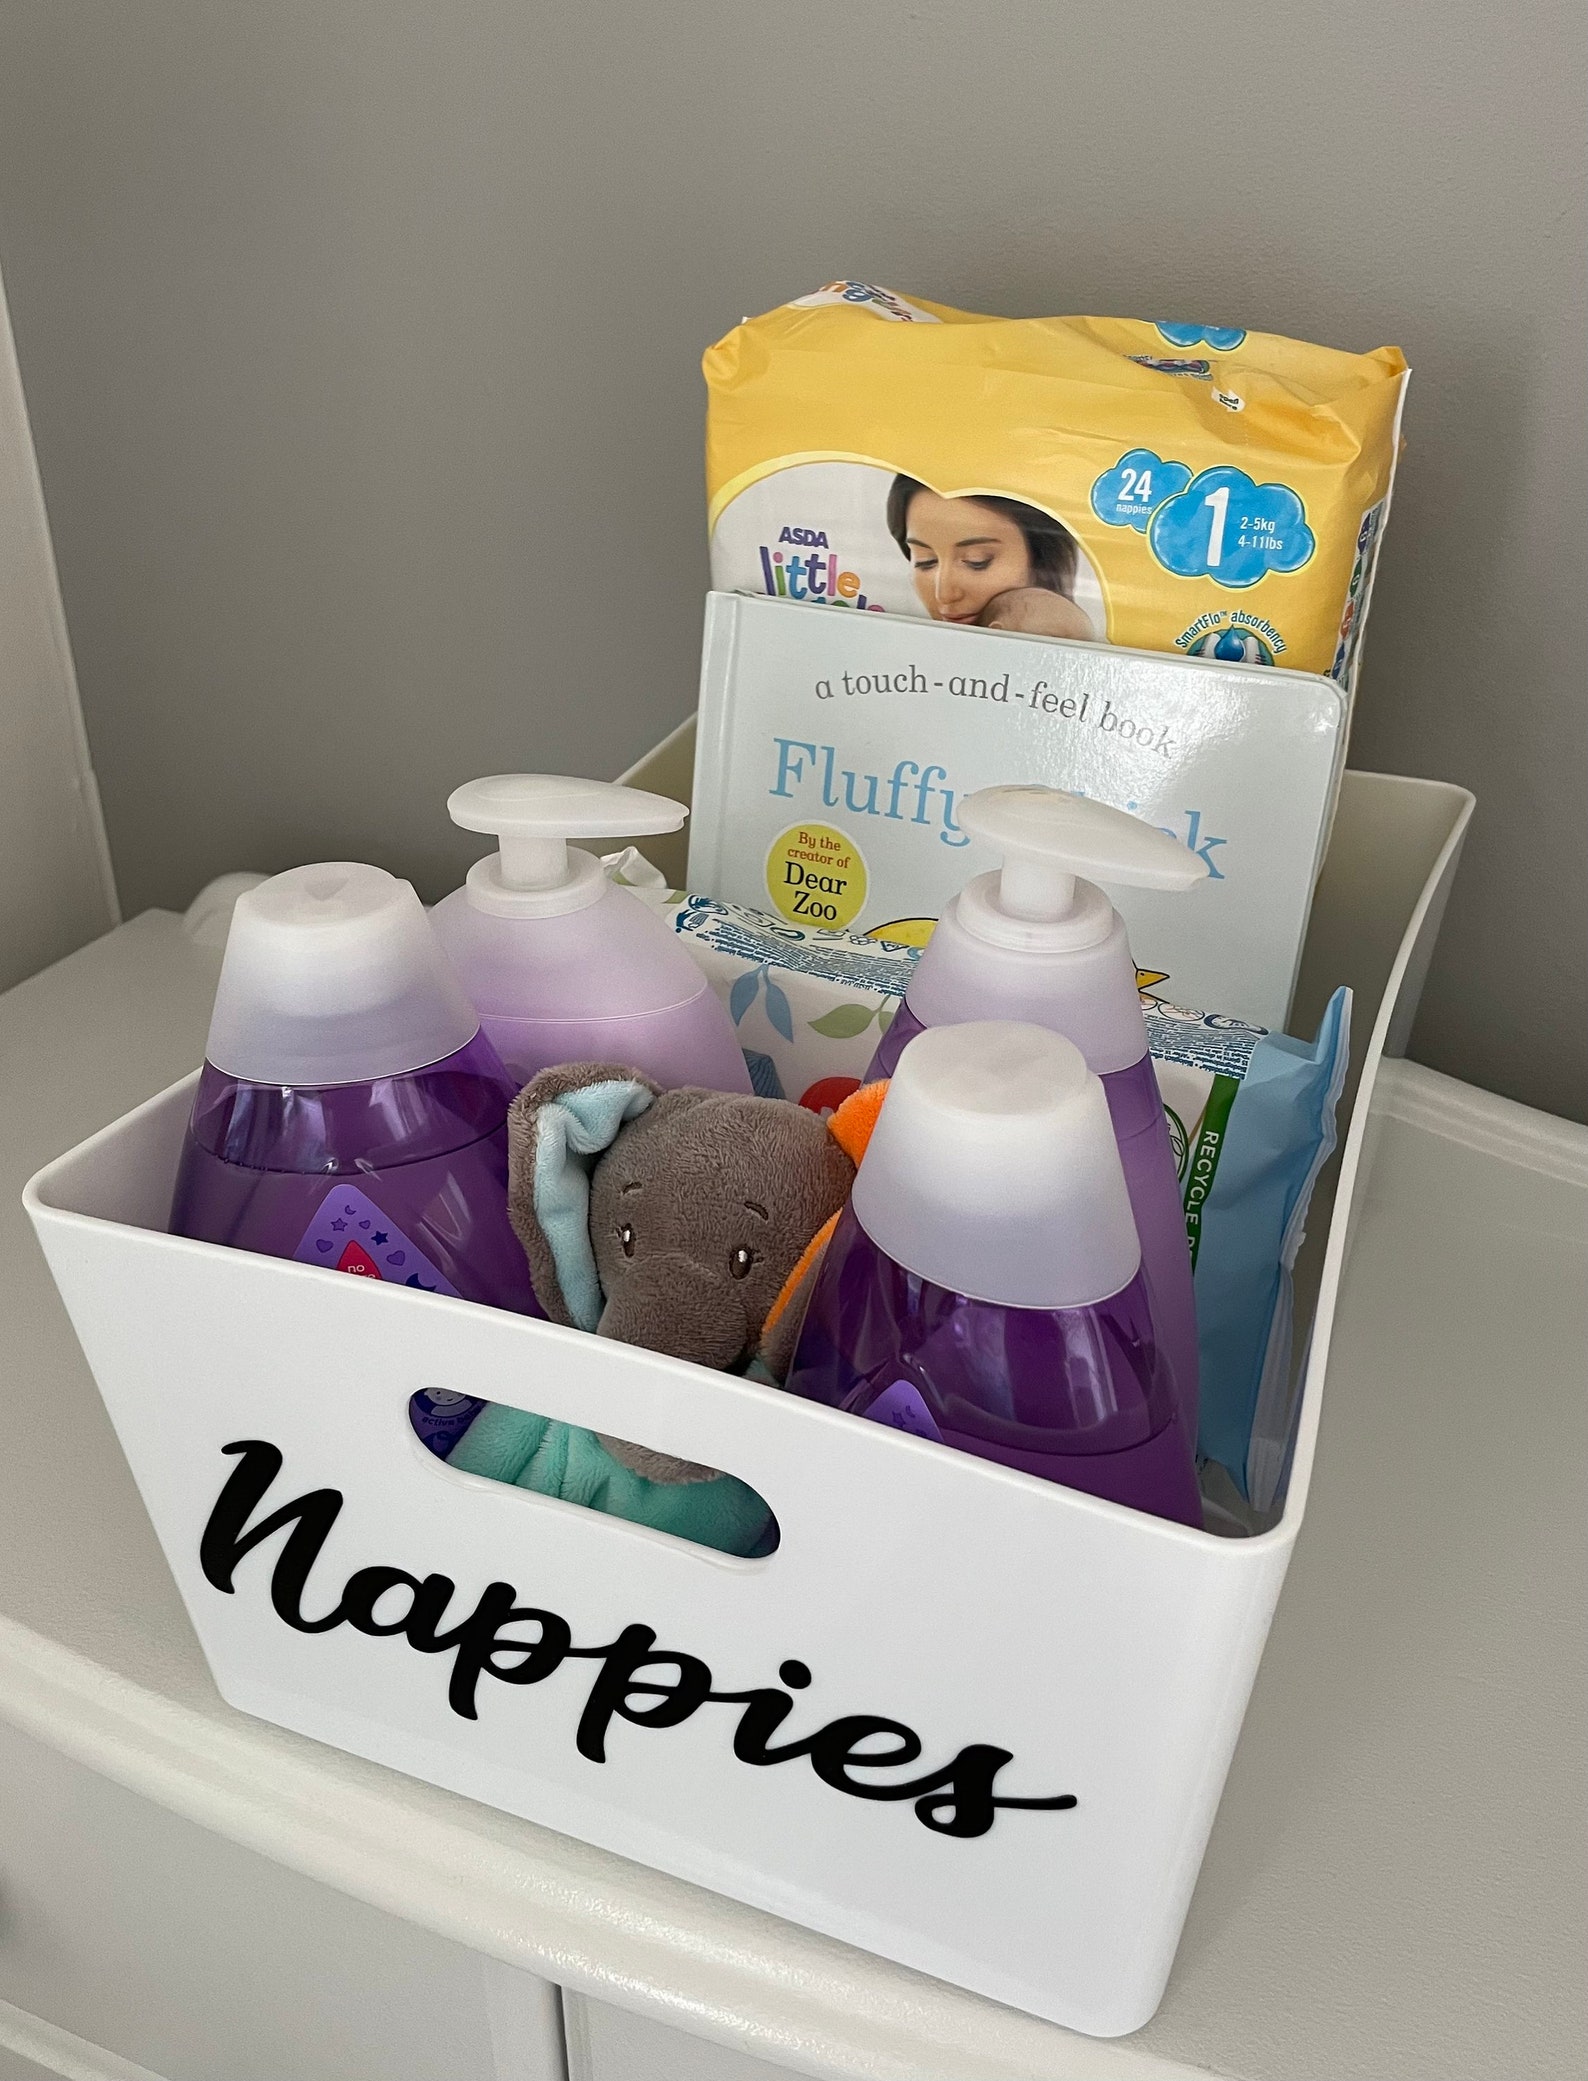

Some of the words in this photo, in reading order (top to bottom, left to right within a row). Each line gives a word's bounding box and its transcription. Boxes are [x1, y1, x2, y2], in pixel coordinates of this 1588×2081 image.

[1117, 468, 1153, 503] 24
[1116, 503, 1153, 515] nappies
[1239, 516, 1276, 532] 2-5kg
[778, 526, 829, 549] ASDA
[1204, 486, 1230, 567] 1
[1237, 535, 1283, 550] 4-11lbs
[759, 545, 861, 600] little
[1230, 609, 1287, 654] absorbency
[815, 680, 835, 700] a
[1099, 700, 1177, 761] book
[798, 831, 816, 849] By
[820, 836, 841, 851] the
[787, 848, 834, 865] creator
[836, 857, 851, 869] of
[783, 861, 847, 895] Dear
[792, 890, 837, 921] Zoo
[1186, 1130, 1220, 1225] RECYCLE
[347, 1264, 365, 1273] no
[198, 1439, 1078, 1838] Nappies
